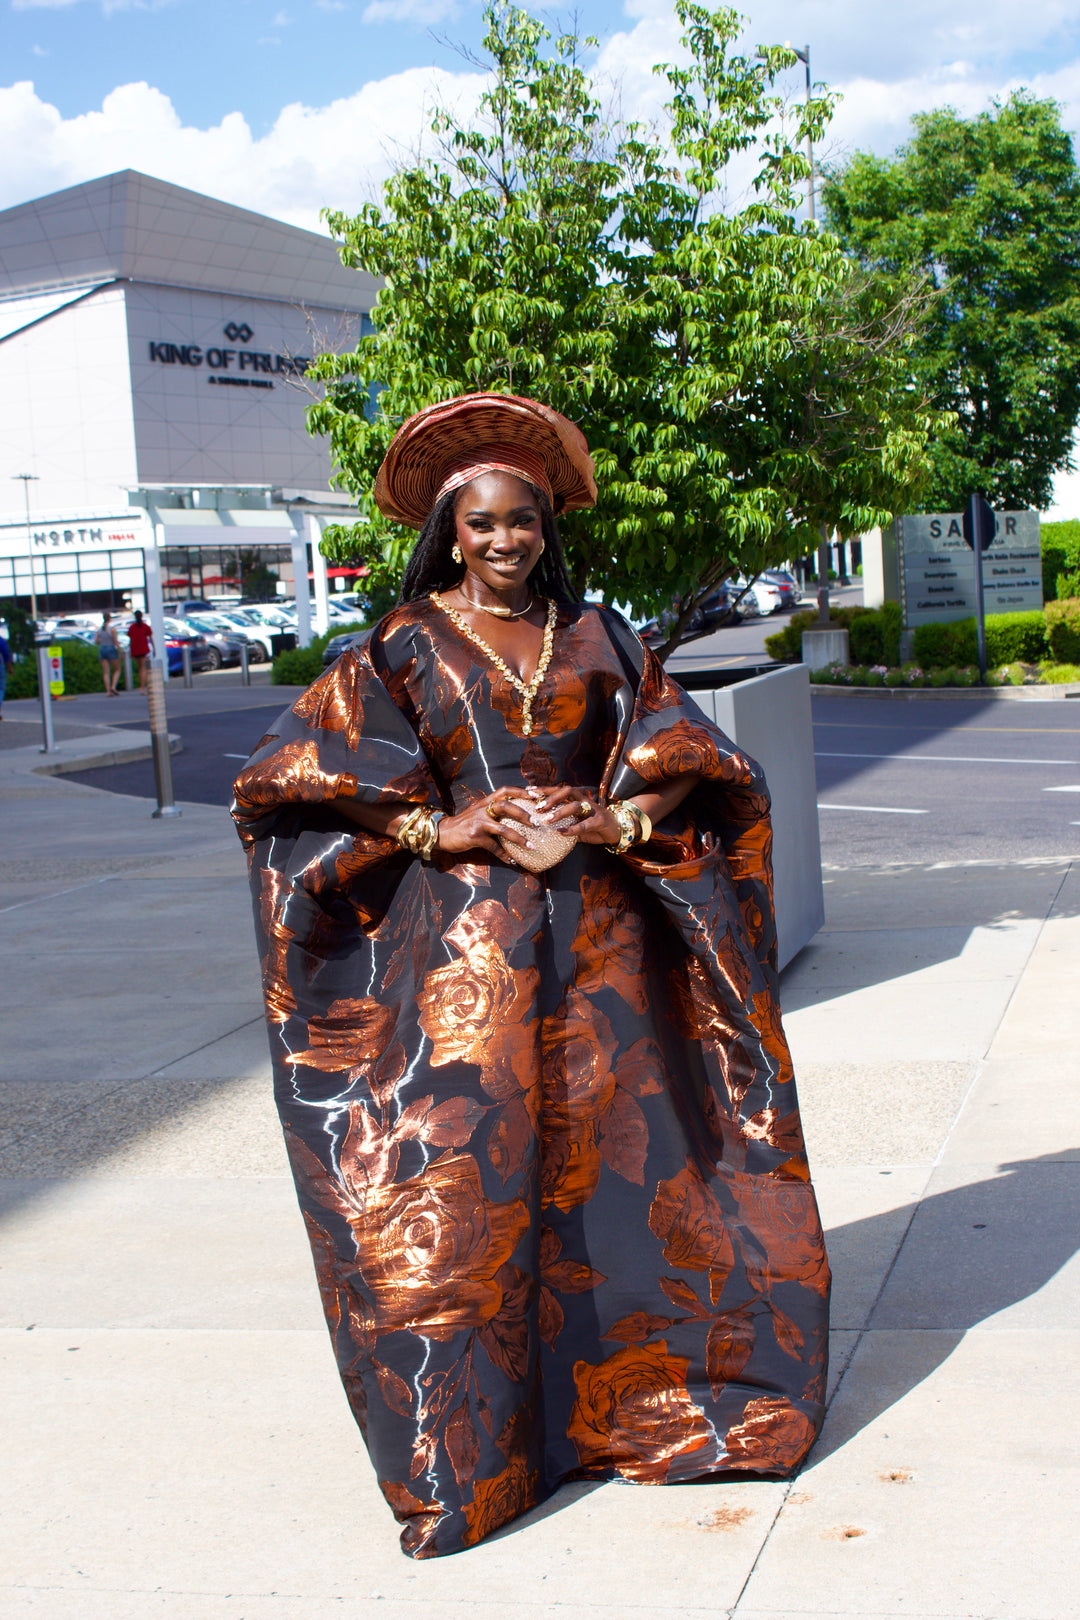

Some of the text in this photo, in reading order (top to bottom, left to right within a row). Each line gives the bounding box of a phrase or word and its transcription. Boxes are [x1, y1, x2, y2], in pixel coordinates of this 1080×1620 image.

[149, 341, 310, 376] KING OF PRUSS
[33, 527, 103, 547] NORTH
[930, 516, 1017, 538] SAR
